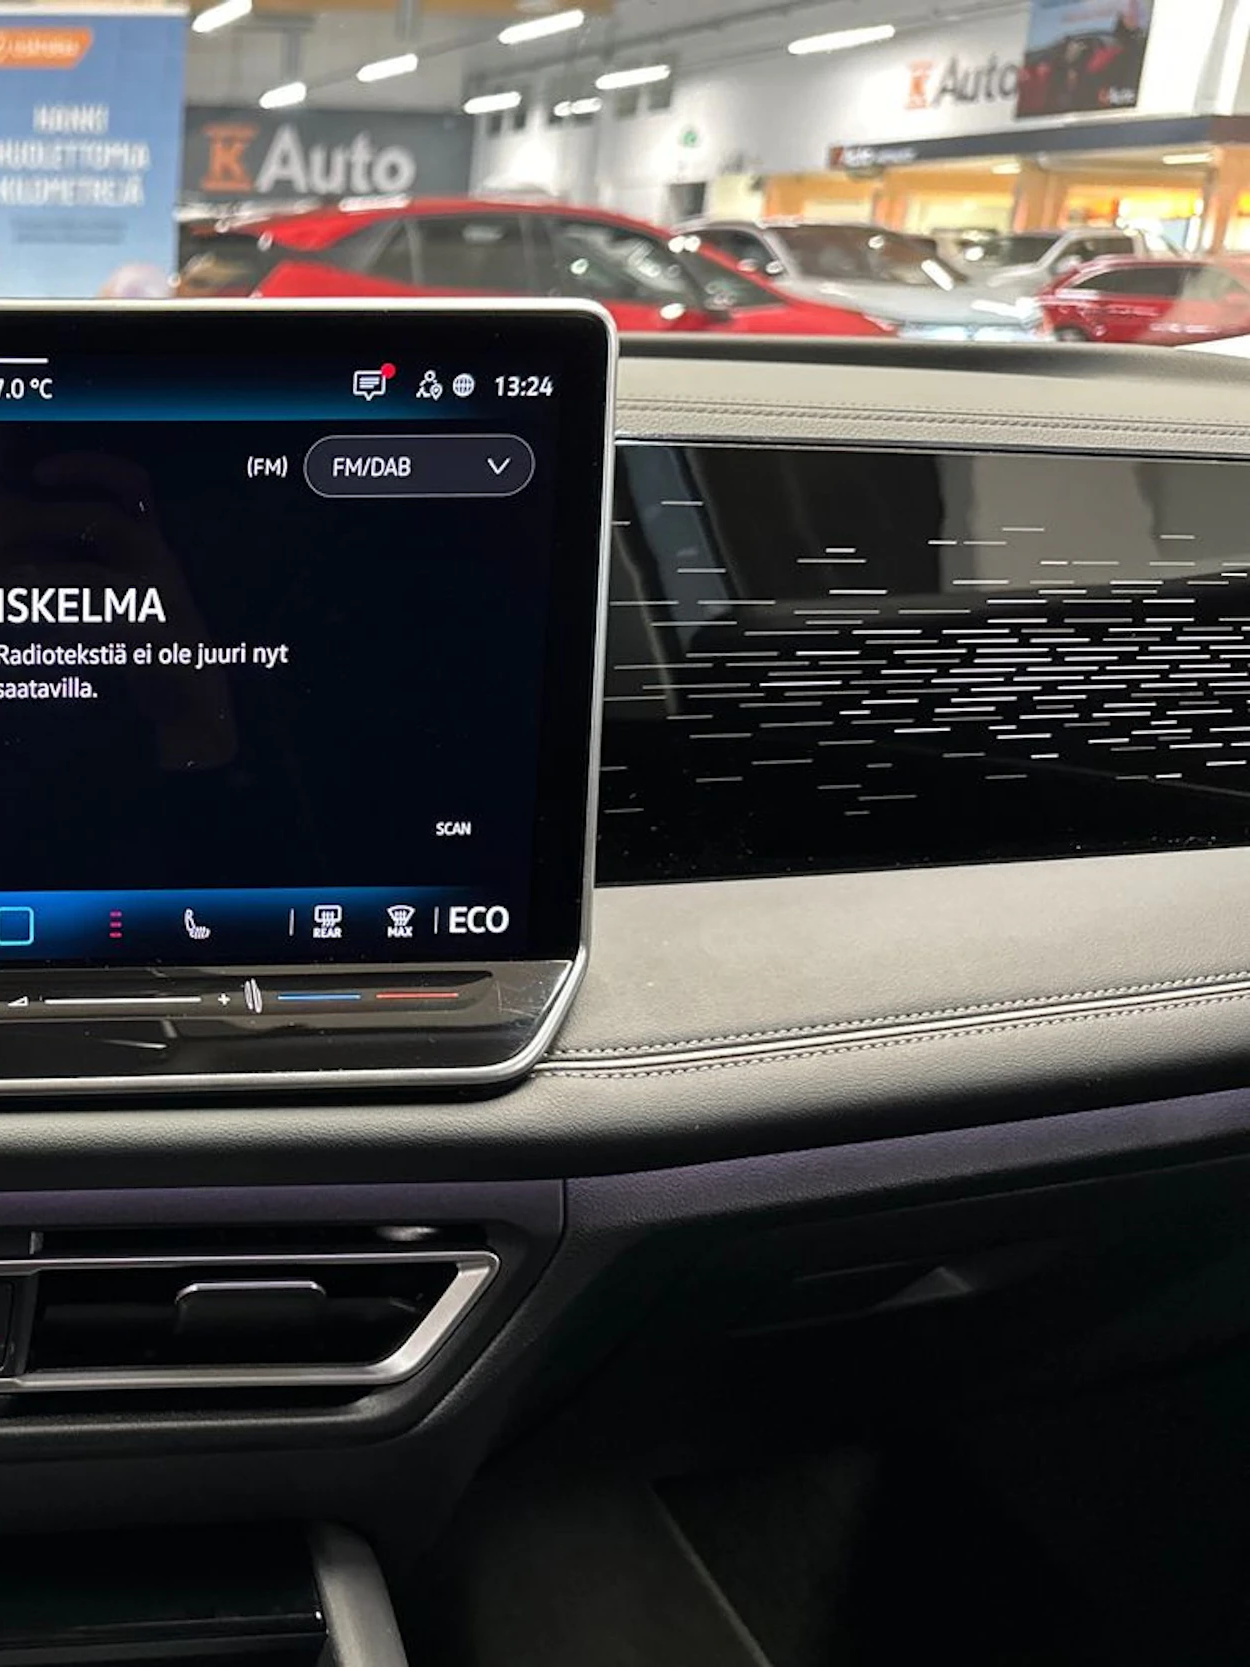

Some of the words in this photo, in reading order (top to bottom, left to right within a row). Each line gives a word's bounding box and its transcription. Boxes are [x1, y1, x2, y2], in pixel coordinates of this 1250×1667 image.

[935, 54, 1018, 104] Auto
[203, 122, 258, 191] K
[254, 121, 417, 195] Auto
[494, 375, 553, 397] 13:24
[246, 455, 289, 480] (FM)
[332, 457, 412, 478] FM/DAB
[132, 644, 152, 665] ei
[157, 643, 191, 665] ole
[194, 643, 246, 670] juuri
[252, 644, 289, 669] nyt
[435, 821, 472, 836] SCAN
[448, 905, 511, 934] ECO
[312, 926, 343, 939] REAR
[387, 926, 414, 938] MAX
